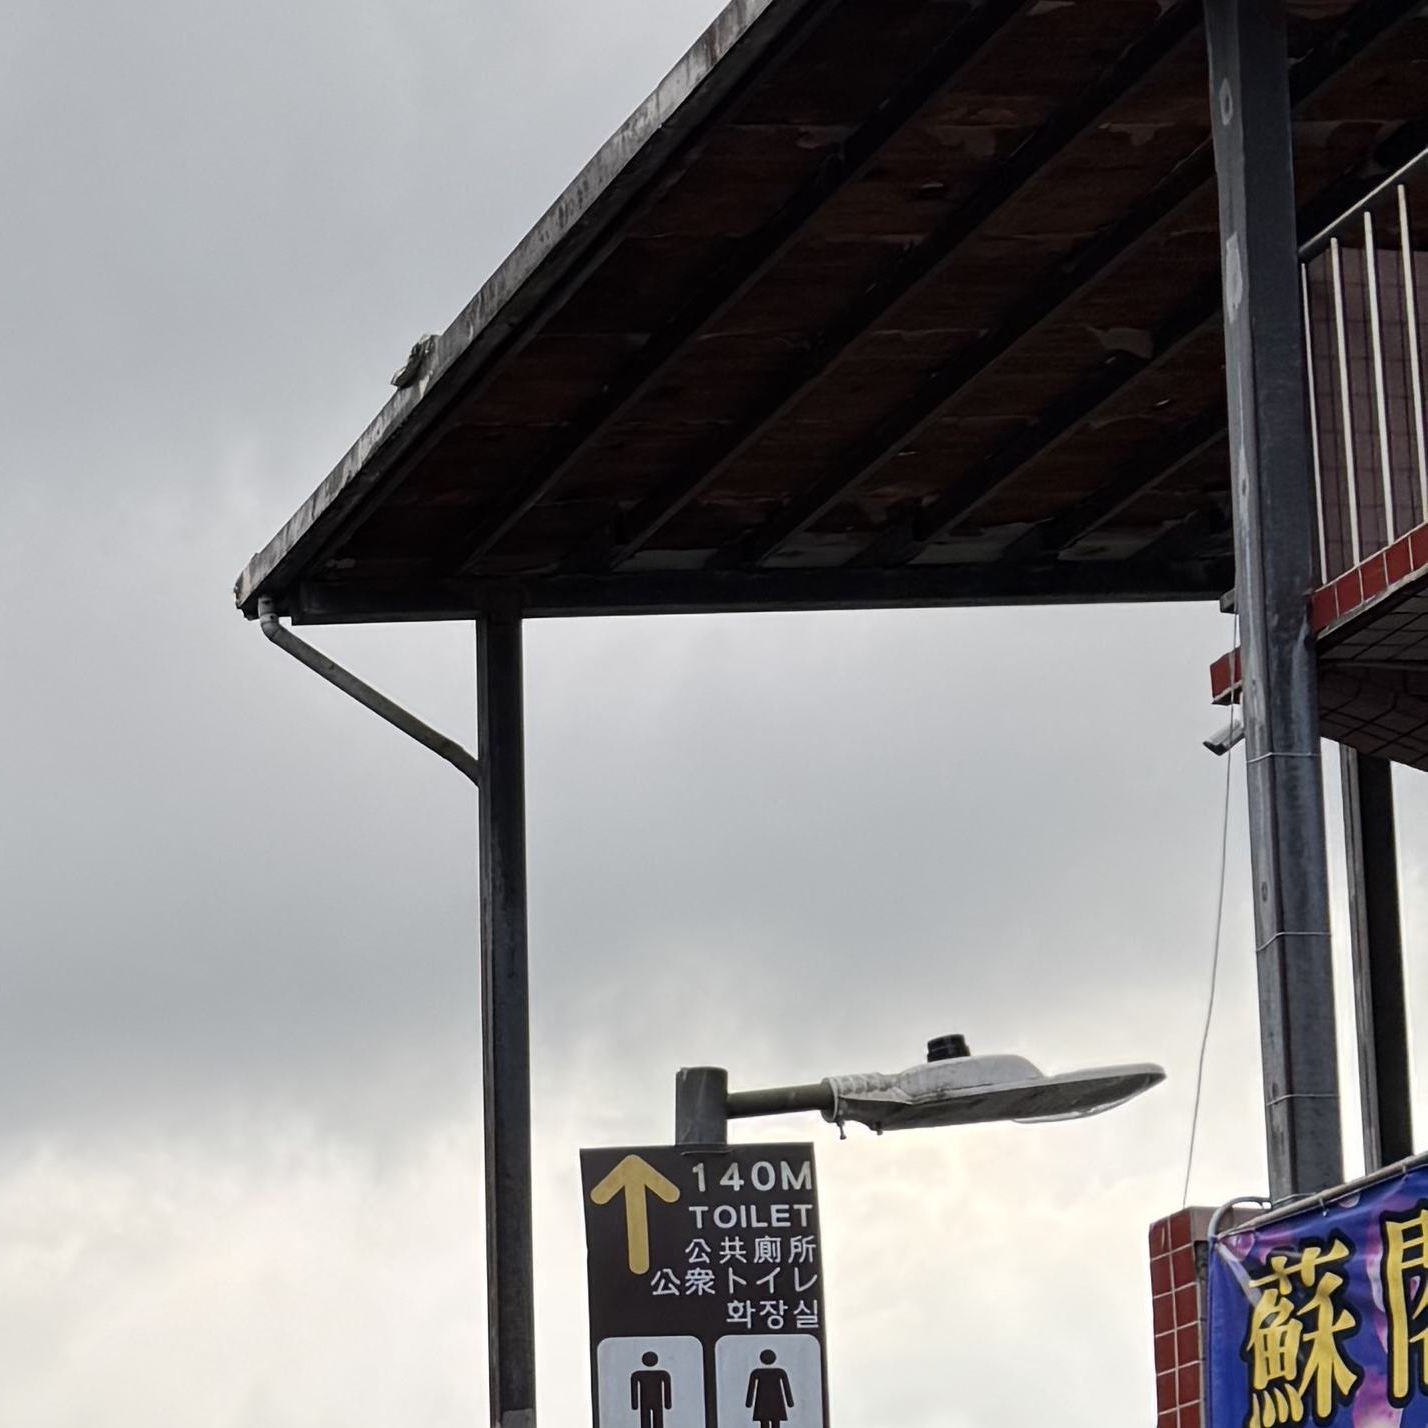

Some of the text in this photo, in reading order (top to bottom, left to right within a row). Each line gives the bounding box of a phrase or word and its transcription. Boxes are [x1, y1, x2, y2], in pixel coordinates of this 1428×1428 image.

[692, 1161, 813, 1192] 140M
[688, 1204, 813, 1229] TOILET
[685, 1235, 816, 1264] 公共廁所
[726, 1300, 820, 1330] 화장실
